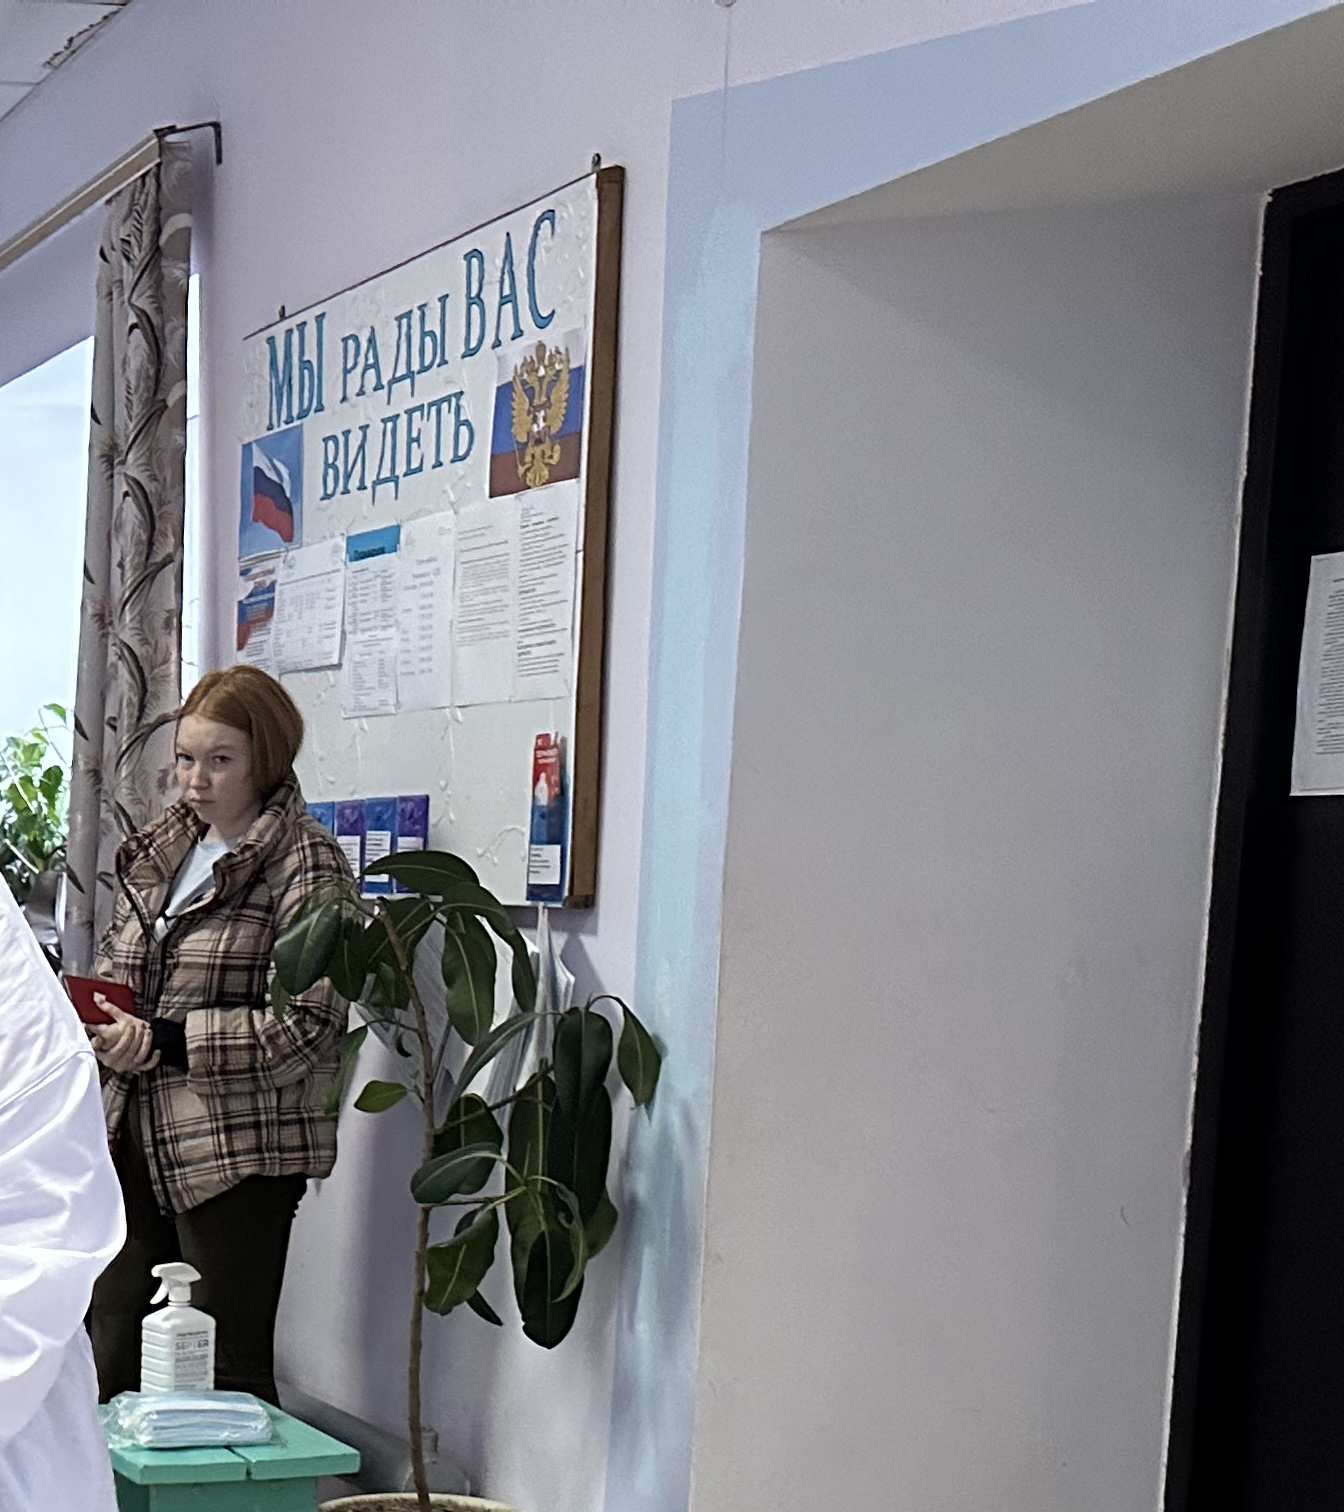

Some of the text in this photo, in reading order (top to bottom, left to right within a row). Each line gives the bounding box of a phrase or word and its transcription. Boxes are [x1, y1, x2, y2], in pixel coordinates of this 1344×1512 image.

[266, 208, 557, 431] МЫ РАДЫ ВАС
[319, 391, 475, 506] ВИДЕТЬ
